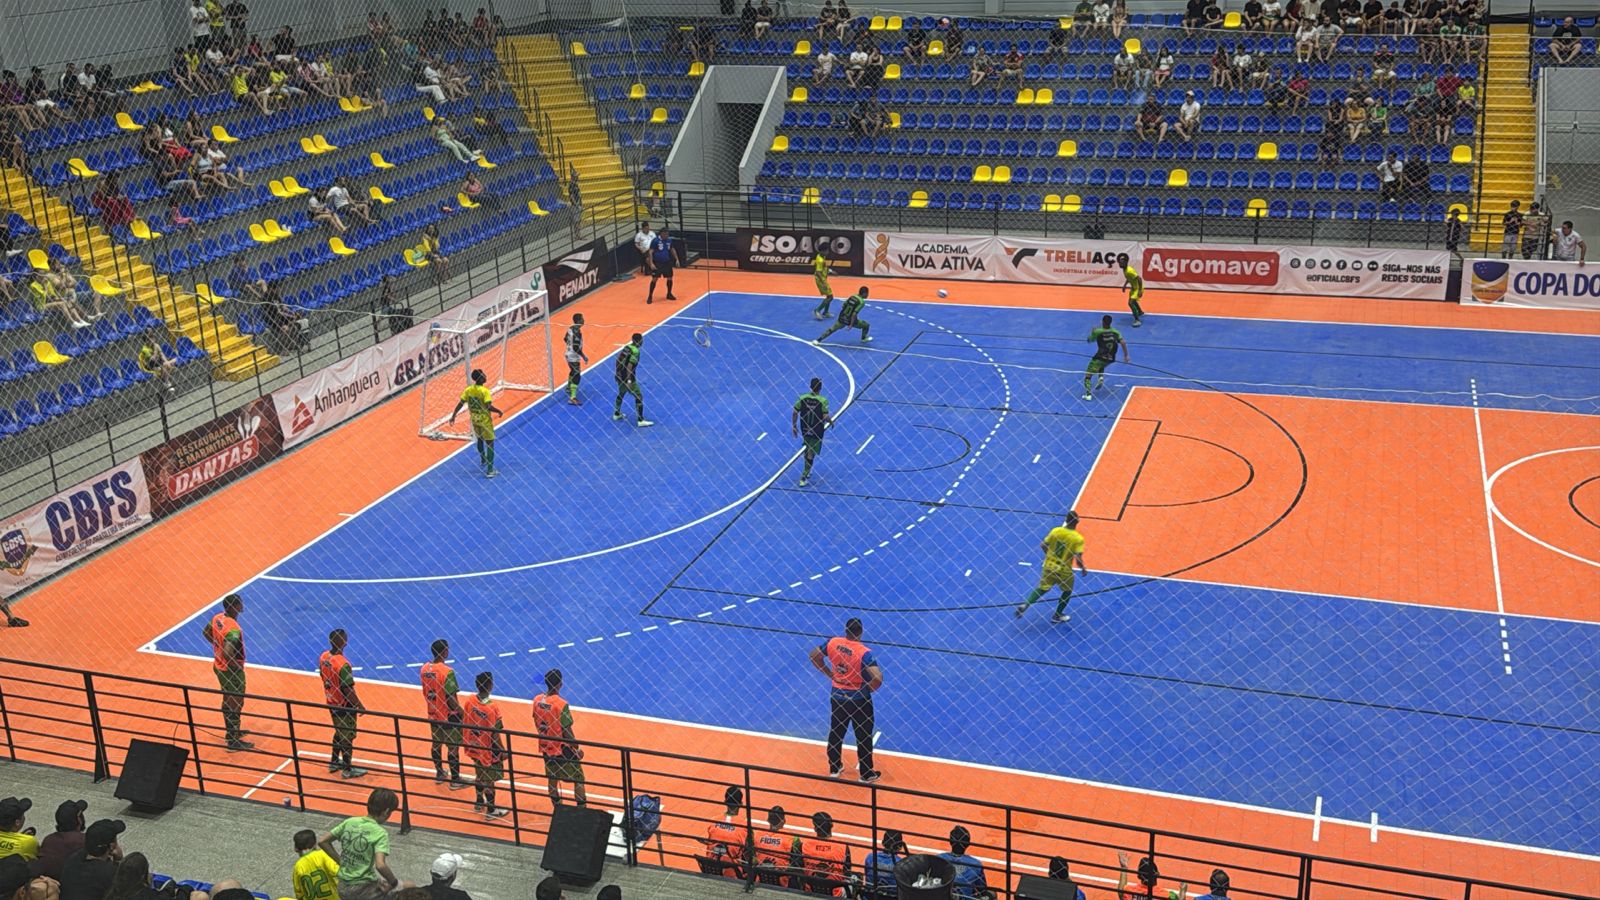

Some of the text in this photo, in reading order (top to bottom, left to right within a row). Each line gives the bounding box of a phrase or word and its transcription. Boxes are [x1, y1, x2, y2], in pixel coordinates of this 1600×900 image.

[749, 255, 811, 264] CENTRO-OESTE
[914, 243, 969, 254] ACADEMIA
[898, 254, 986, 271] VIDA ATIVA
[1147, 252, 1271, 278] Agromave
[1424, 265, 1441, 274] NAS
[559, 267, 599, 303] PENALTY
[1306, 274, 1361, 284] @OFICIALCBFS
[1381, 273, 1444, 284] REDES SOCIAIS
[1513, 271, 1600, 297] COPA DO
[313, 370, 381, 416] Anhanguera
[175, 423, 235, 458] RESTAURANTE
[174, 440, 254, 496] DANTAS
[45, 470, 137, 552] CBFS
[300, 868, 332, 900] 02
